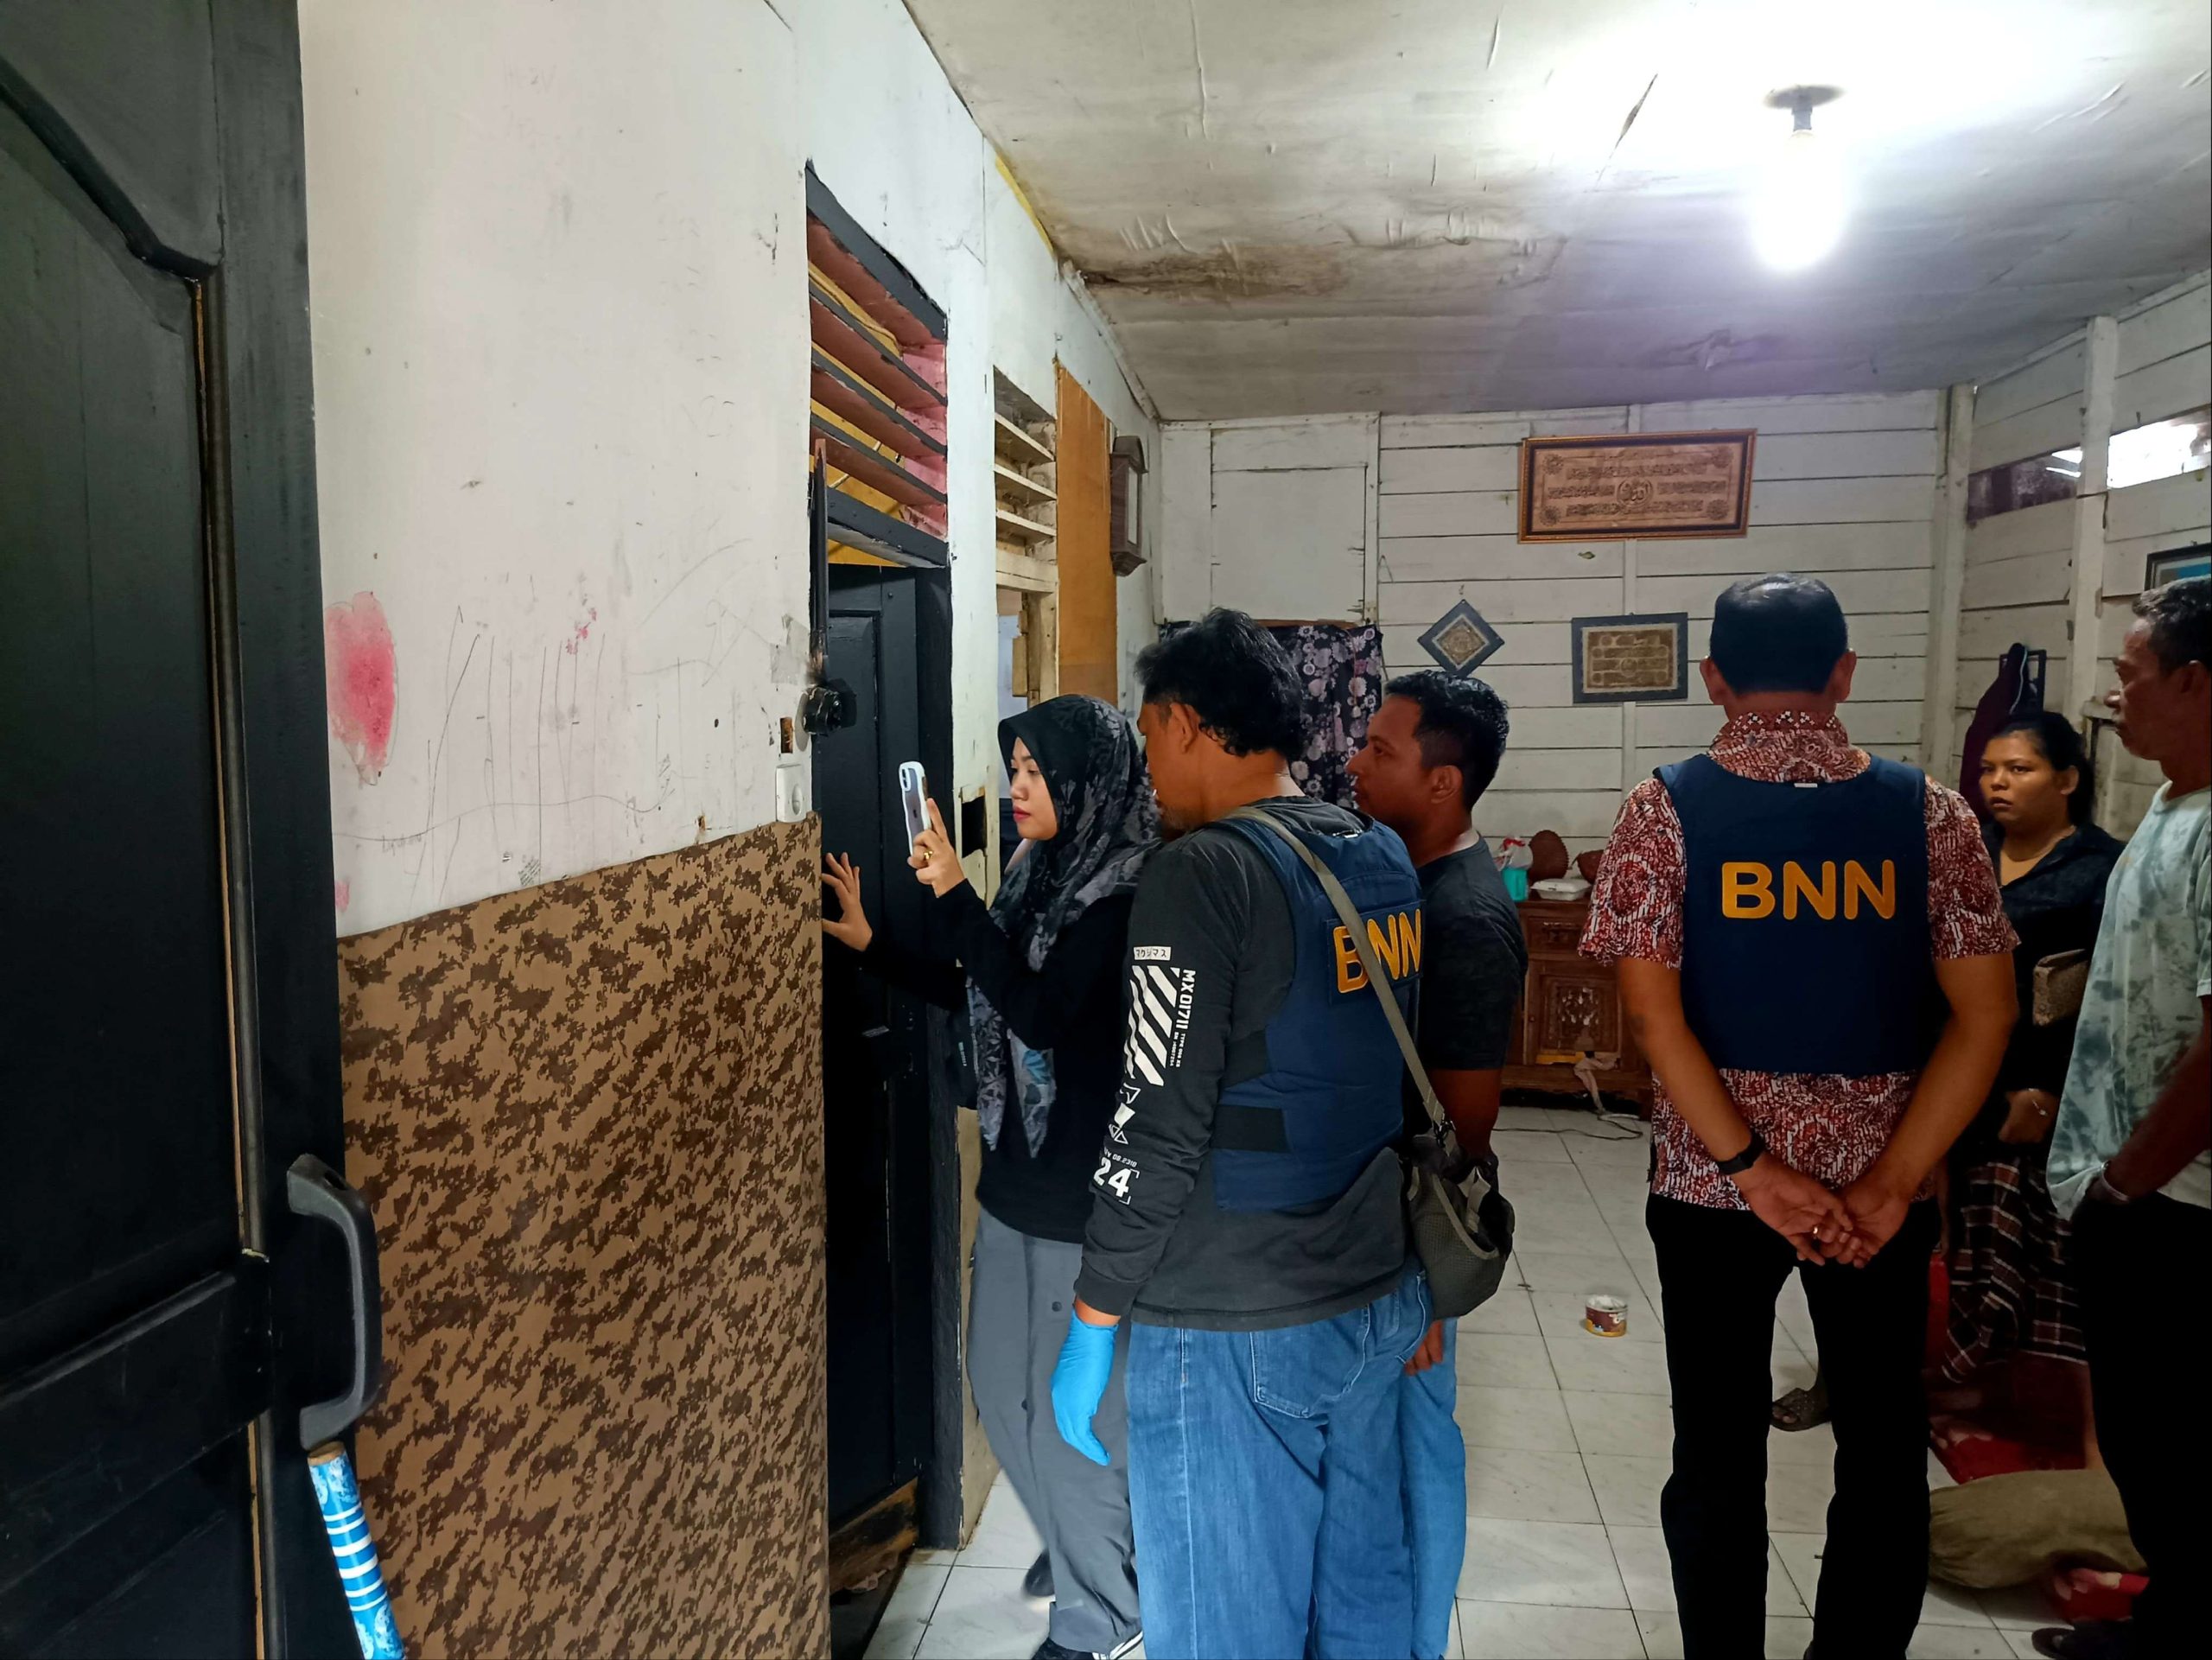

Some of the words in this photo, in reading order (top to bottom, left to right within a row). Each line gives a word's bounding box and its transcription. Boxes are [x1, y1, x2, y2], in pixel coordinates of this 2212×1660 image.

[1722, 860, 1895, 919] BNN
[1333, 909, 1421, 993] BNN
[1093, 1157, 1132, 1198] 24
